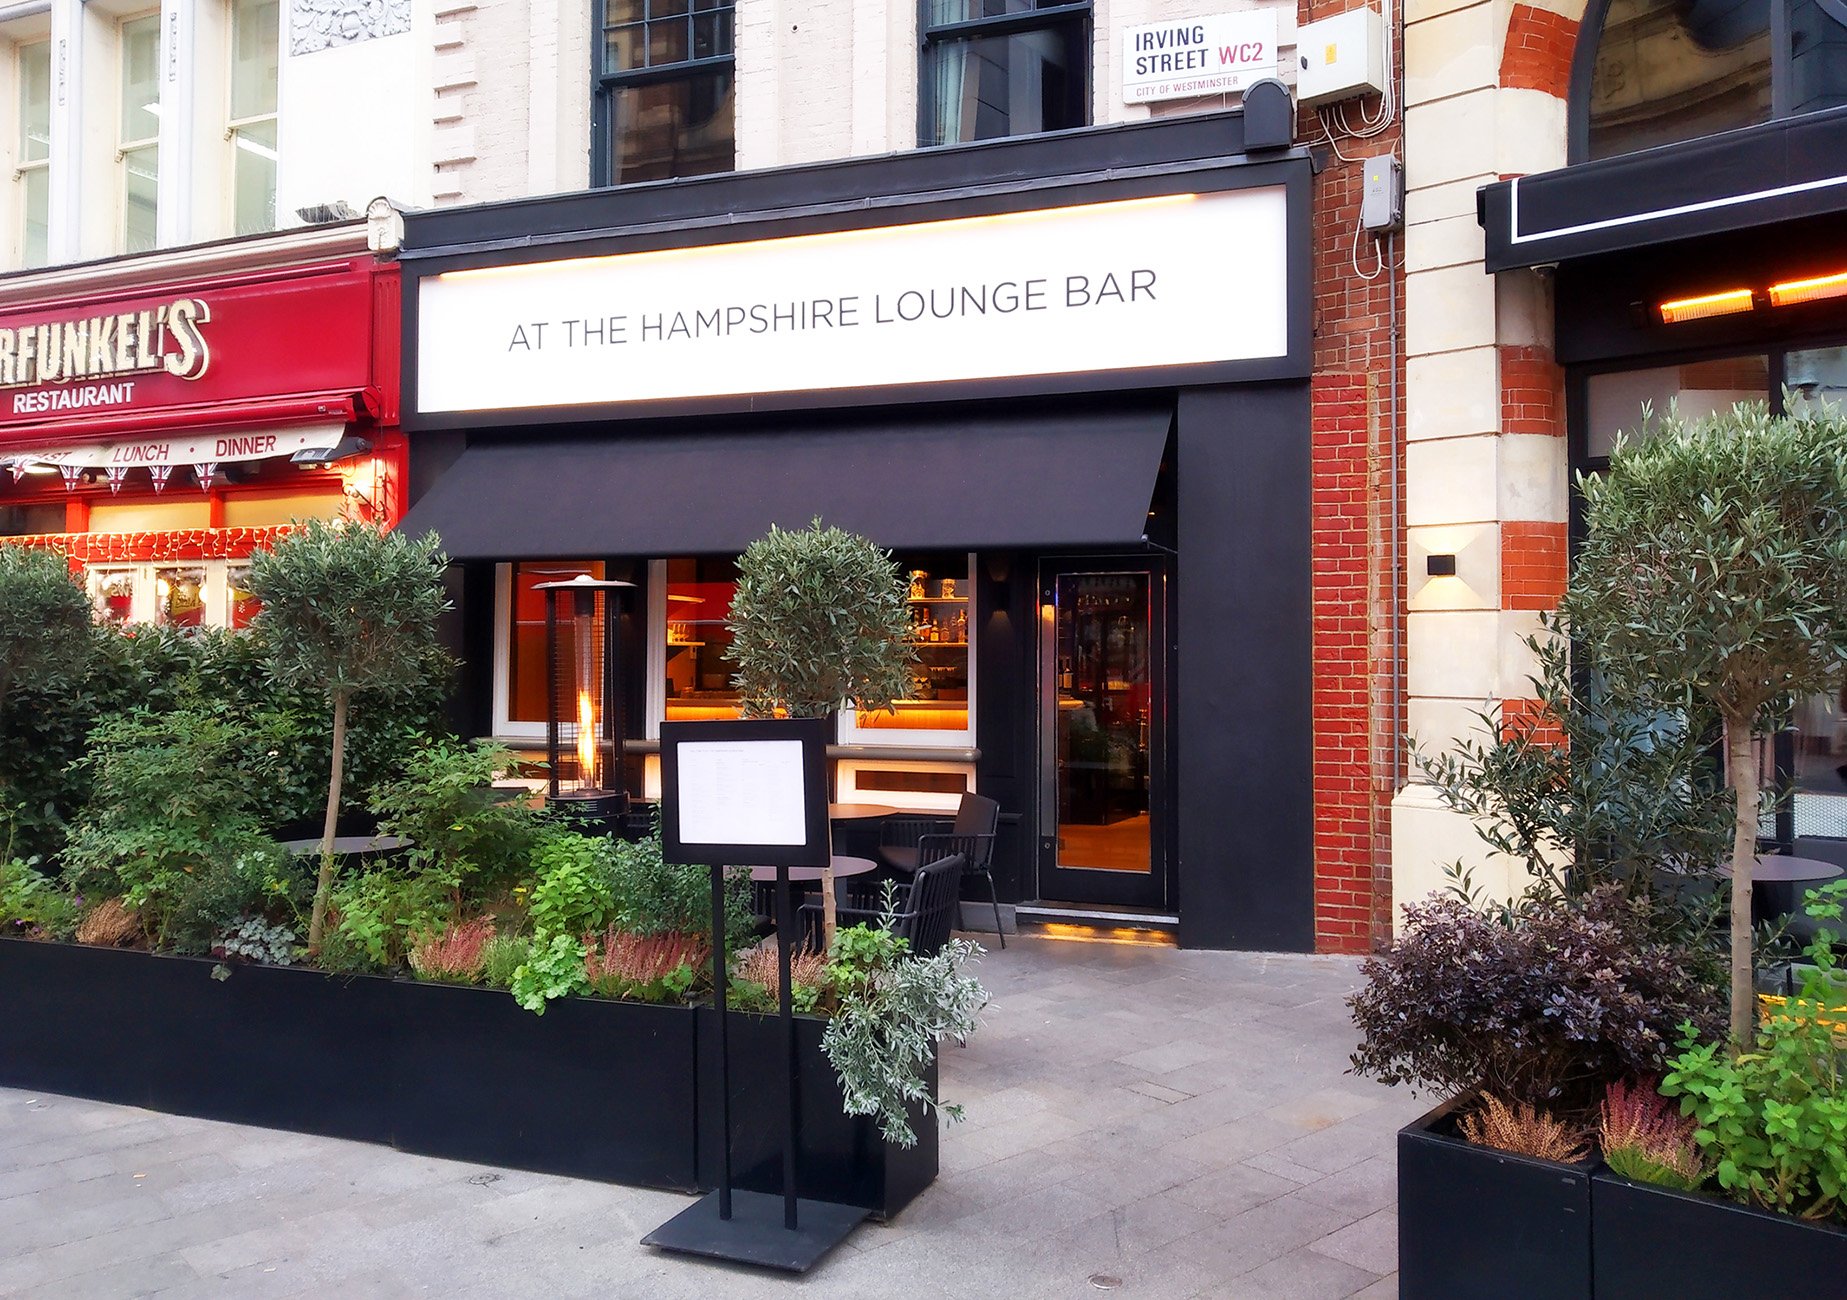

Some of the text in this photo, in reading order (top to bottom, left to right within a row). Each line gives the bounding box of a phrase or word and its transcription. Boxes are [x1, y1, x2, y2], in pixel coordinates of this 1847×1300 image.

[1135, 25, 1205, 52] IRVING
[1135, 42, 1263, 76] STREET WC2
[1136, 76, 1239, 97] CITY OF WESTMINSTER
[508, 269, 1158, 353] AT THE HAMPSHIRE LOUNGE BAR
[13, 382, 135, 414] RESTAURANT
[112, 435, 277, 463] LUNCH DINNER
